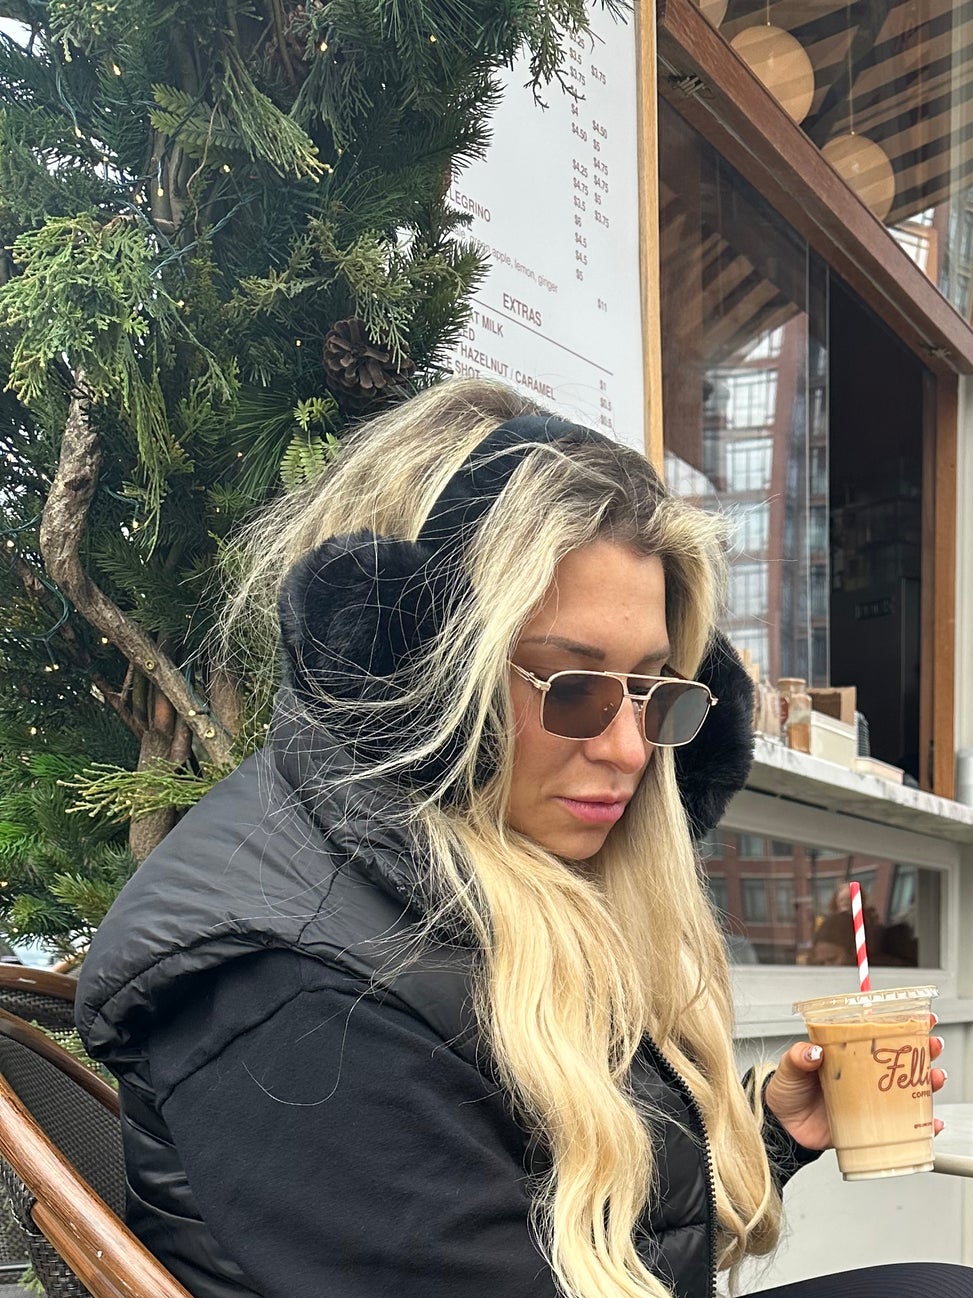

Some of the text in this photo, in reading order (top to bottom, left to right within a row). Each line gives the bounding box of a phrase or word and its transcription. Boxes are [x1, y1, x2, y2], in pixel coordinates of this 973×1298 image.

[571, 121, 588, 142] $4.50
[592, 119, 608, 140] $4.50
[447, 186, 491, 223] LEGRINO
[502, 292, 542, 327] EXTRAS
[481, 314, 505, 338] MILK
[455, 360, 480, 380] SHOT
[460, 342, 508, 378] HAZELNUT
[515, 371, 557, 401] CARAMEL
